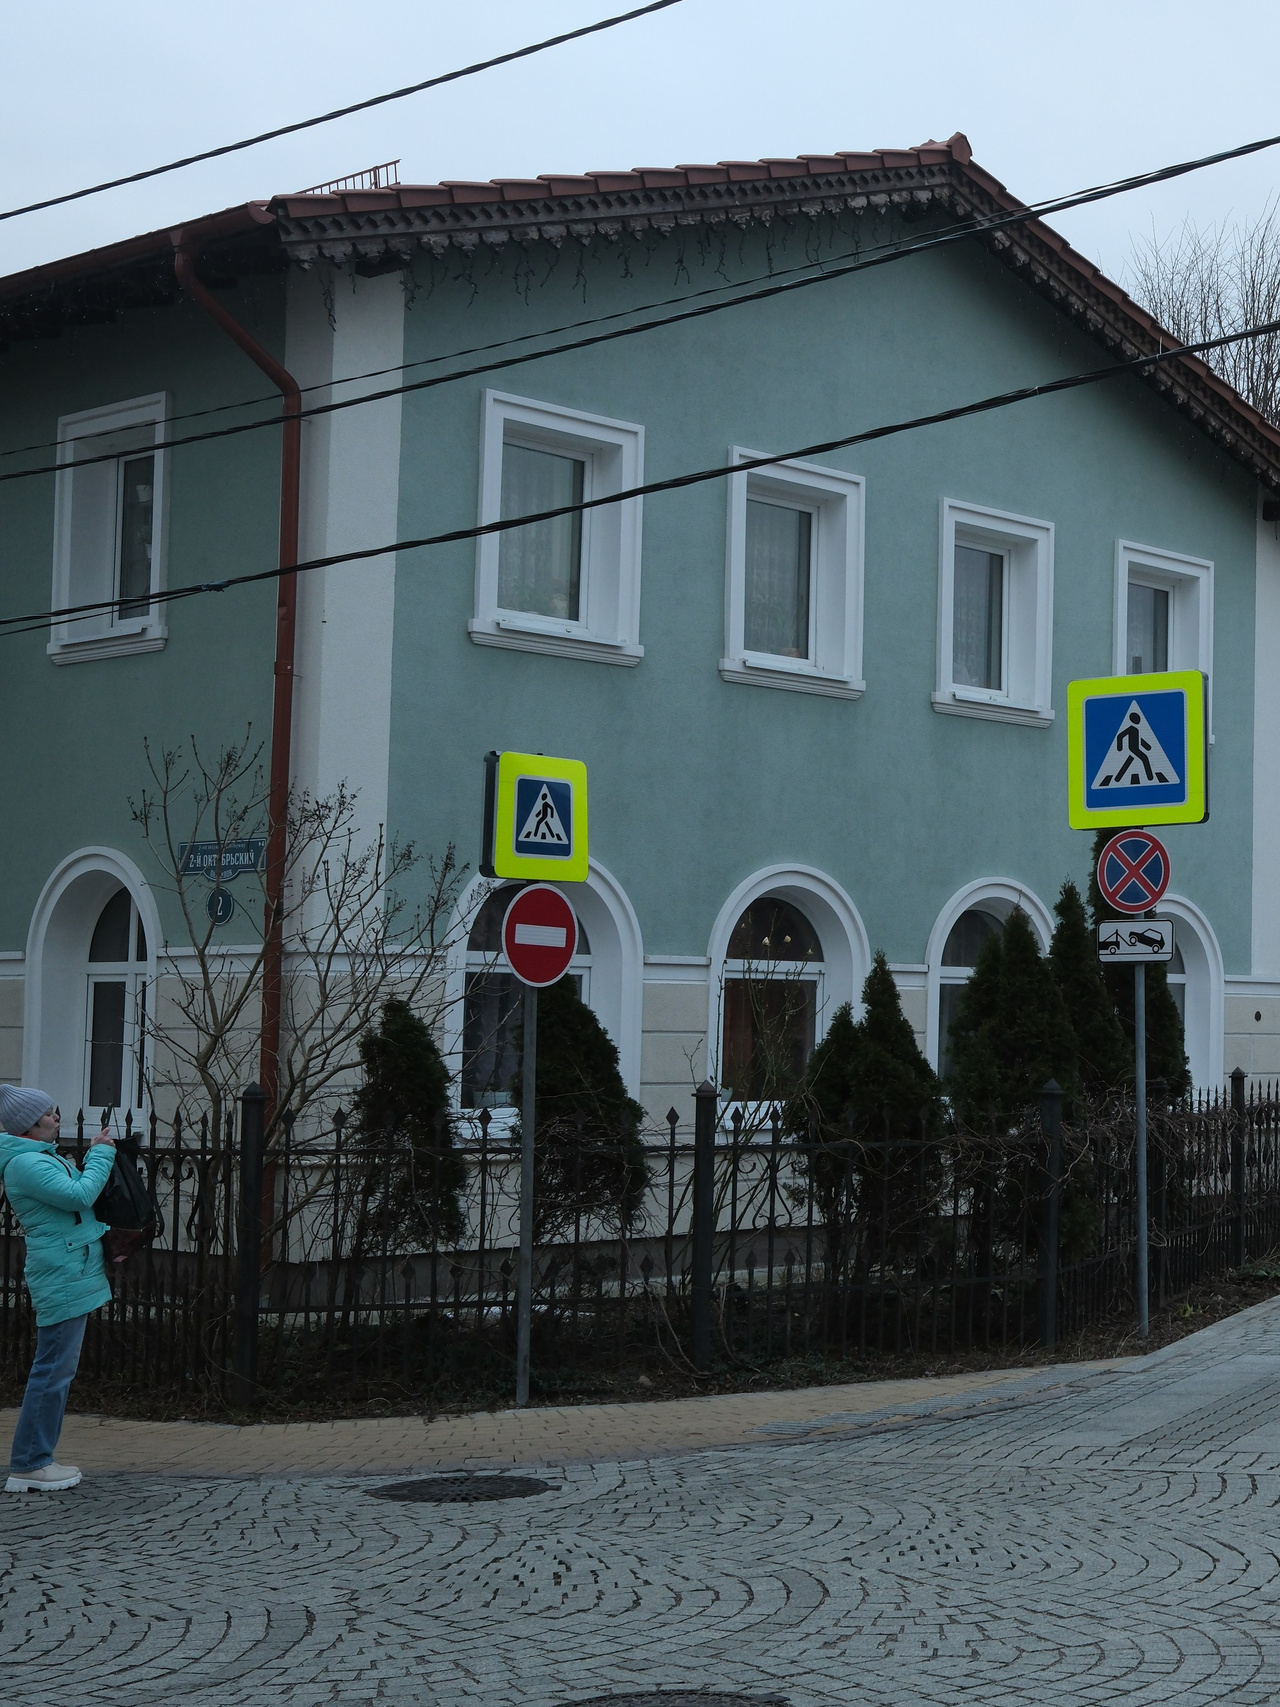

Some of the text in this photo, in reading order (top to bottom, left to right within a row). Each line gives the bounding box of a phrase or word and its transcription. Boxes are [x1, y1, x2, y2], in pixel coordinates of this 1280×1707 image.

[189, 849, 254, 867] 2-Й ОКТБРЬСКИЙ
[217, 896, 223, 916] 2
